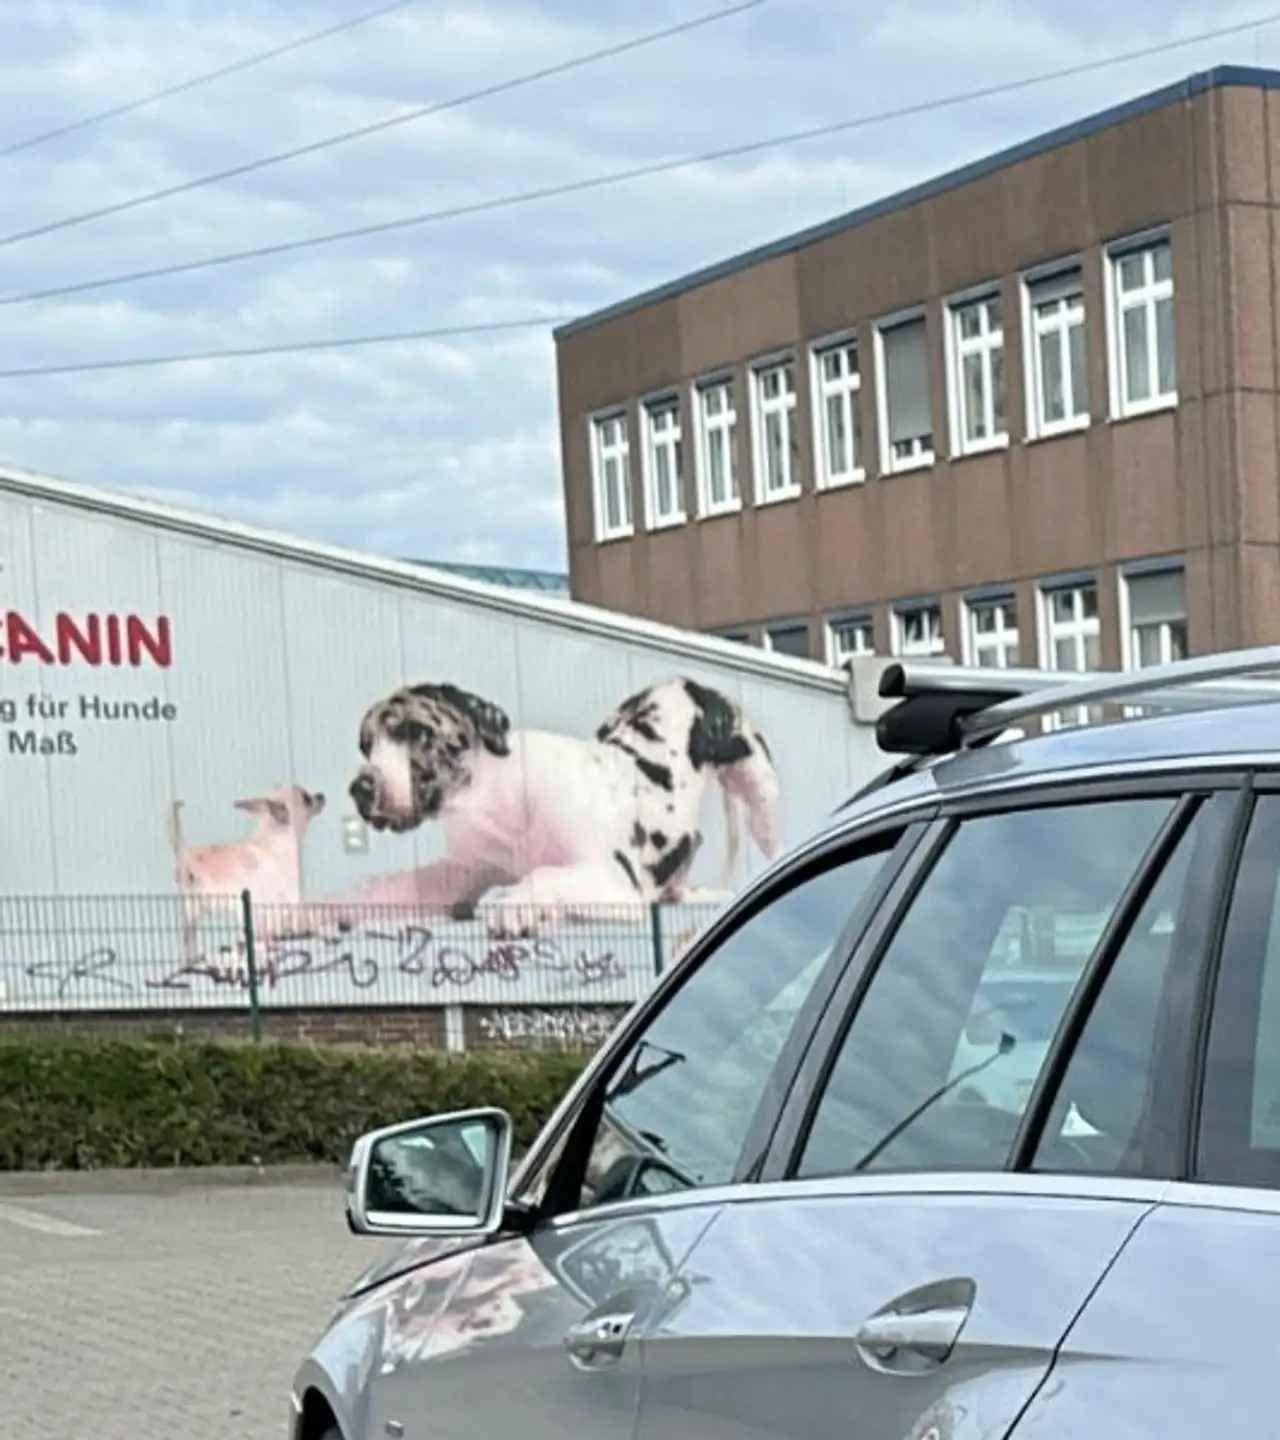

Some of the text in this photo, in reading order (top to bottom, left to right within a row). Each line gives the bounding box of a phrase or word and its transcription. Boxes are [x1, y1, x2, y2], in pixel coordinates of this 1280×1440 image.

[0, 611, 172, 668] ANIN
[26, 693, 69, 719] für
[79, 695, 177, 721] Hunde
[8, 729, 77, 754] Maß
